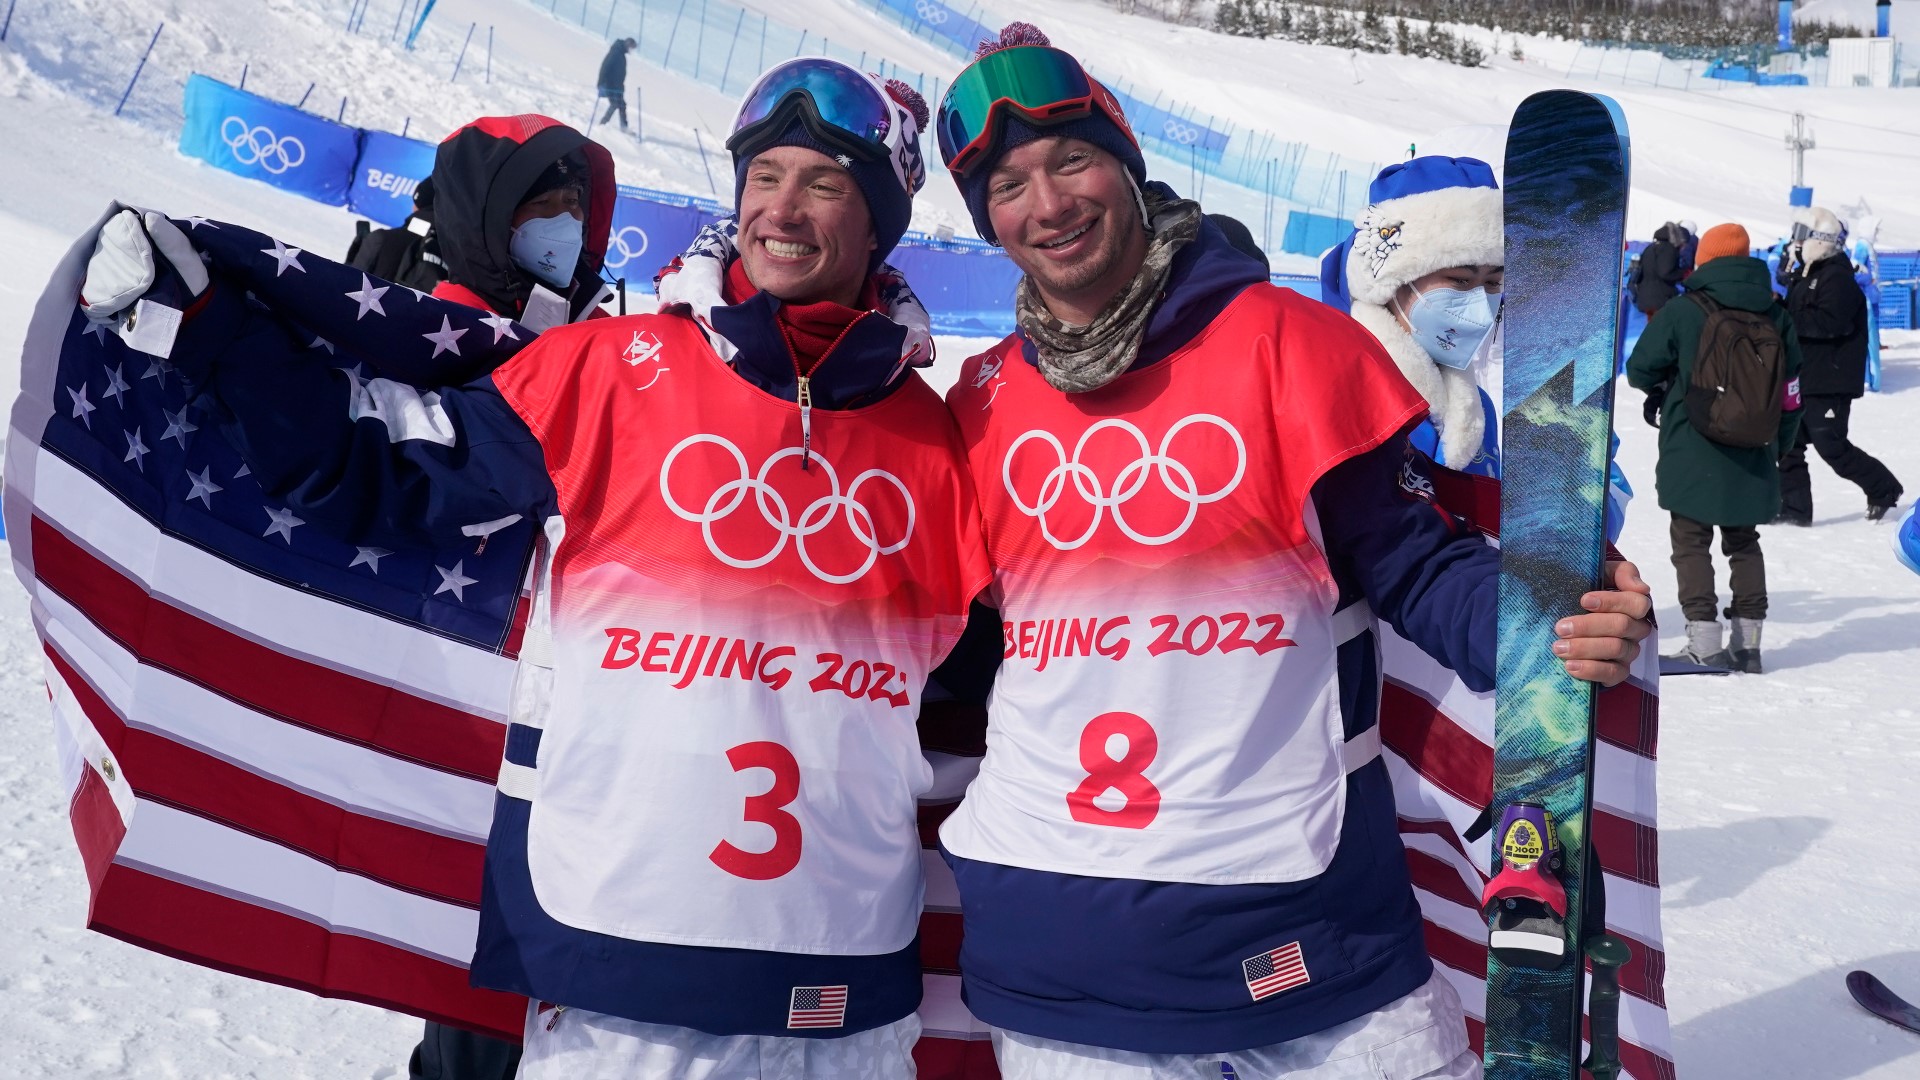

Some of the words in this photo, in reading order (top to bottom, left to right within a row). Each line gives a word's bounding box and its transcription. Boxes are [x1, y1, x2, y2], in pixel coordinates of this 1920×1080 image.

[601, 627, 796, 691] BEIJING
[1146, 612, 1299, 657] 2022
[1066, 711, 1161, 830] 8
[709, 741, 803, 881] 3
[1514, 845, 1539, 854] LOOK
